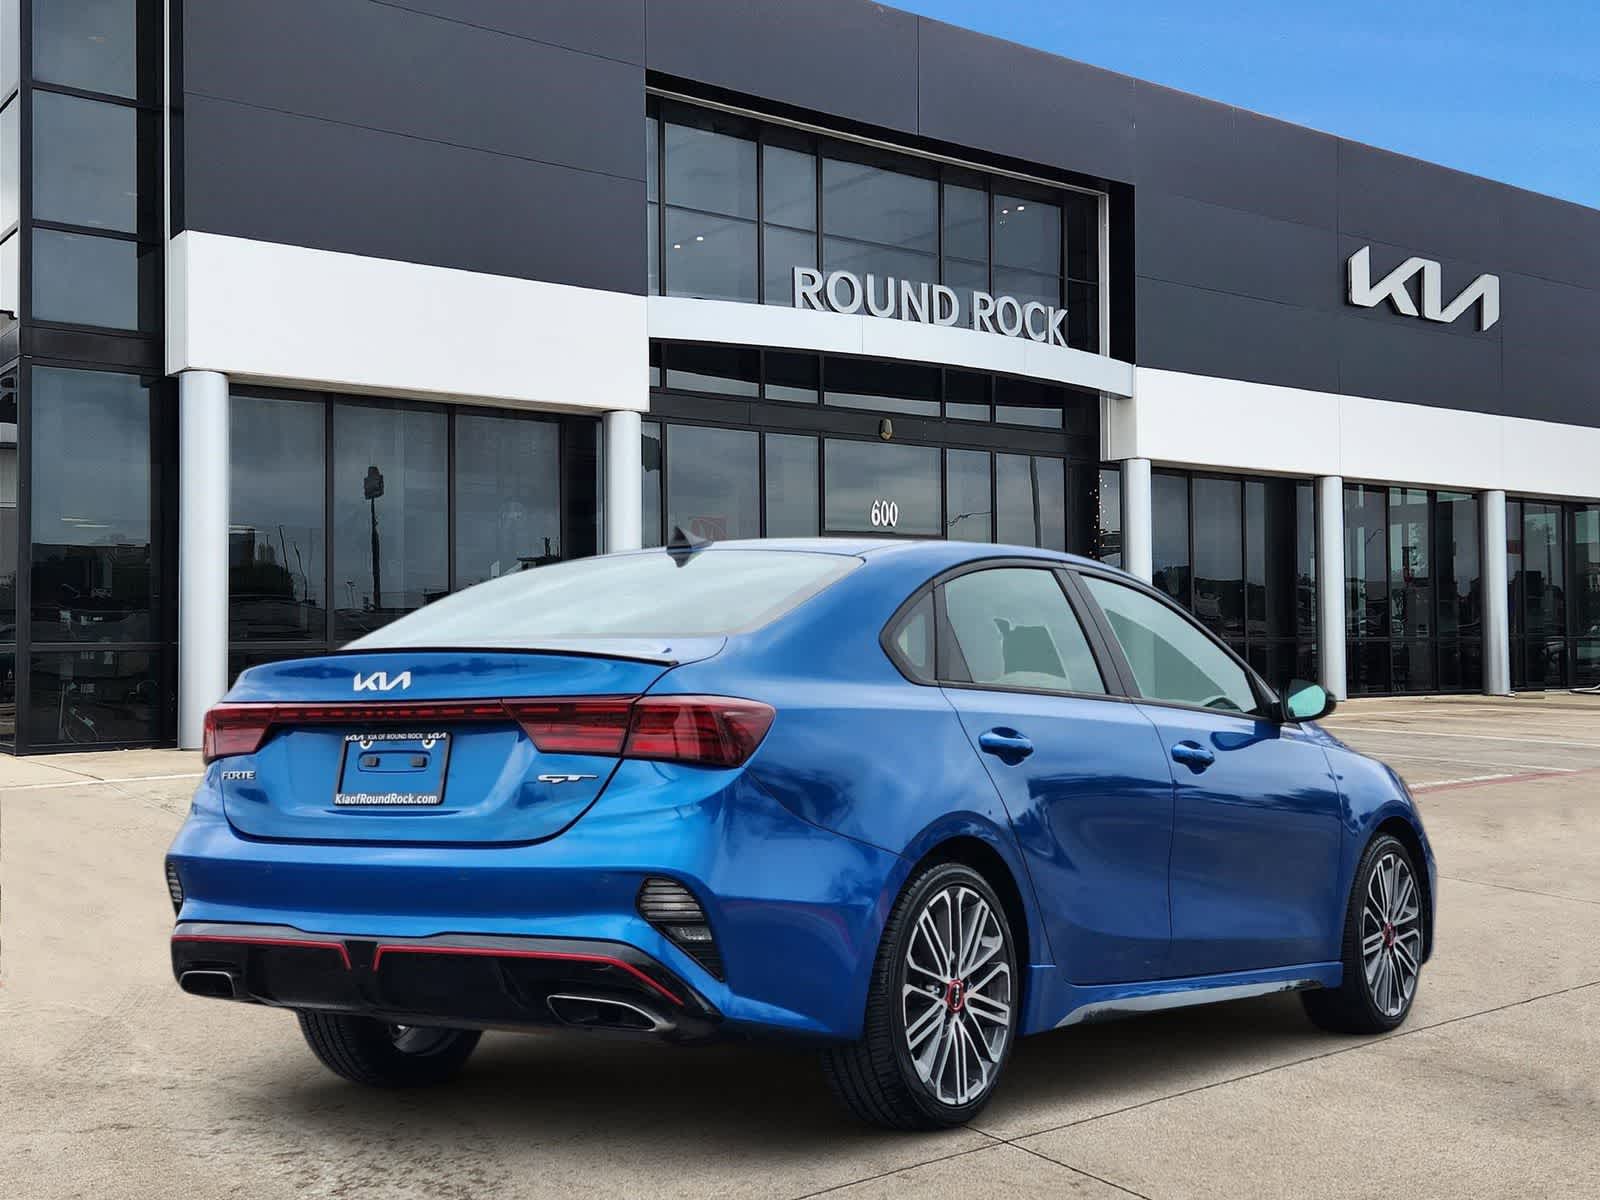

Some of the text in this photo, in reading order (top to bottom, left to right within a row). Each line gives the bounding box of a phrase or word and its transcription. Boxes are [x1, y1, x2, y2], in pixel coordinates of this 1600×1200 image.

[1348, 245, 1500, 332] KIA
[793, 266, 1068, 347] ROUND ROCK
[871, 500, 898, 527] 600
[353, 671, 411, 691] KIA
[223, 770, 256, 780] FORTE
[538, 774, 598, 784] GT
[335, 793, 438, 805] KiaofRoundRock.com
